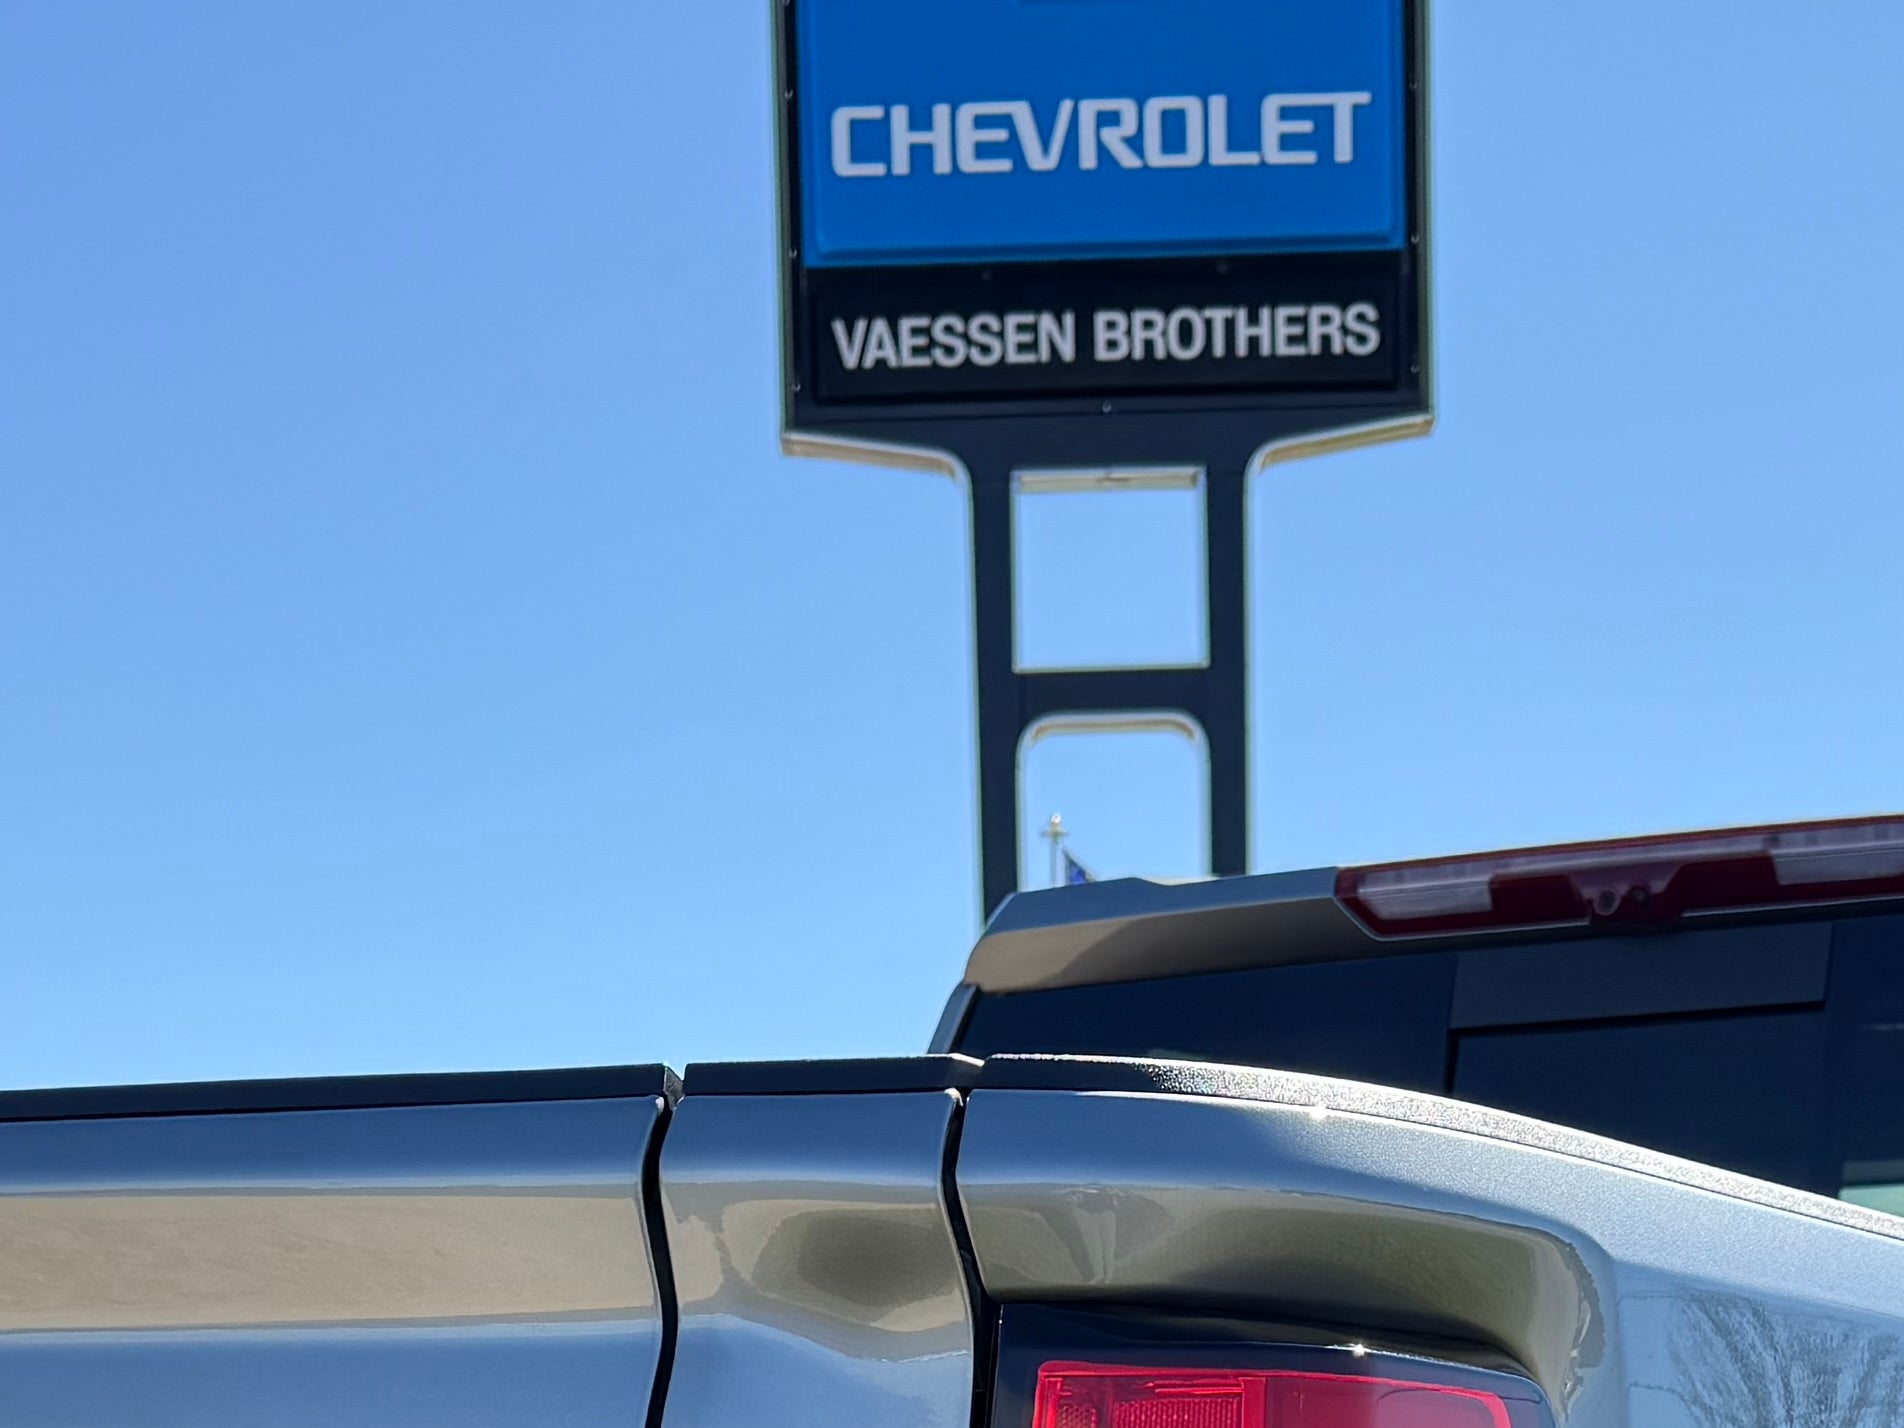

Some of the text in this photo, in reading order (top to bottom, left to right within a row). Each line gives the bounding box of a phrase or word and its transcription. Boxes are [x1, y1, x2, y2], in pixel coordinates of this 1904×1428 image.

[830, 91, 1372, 178] CHEVROLET
[831, 302, 1381, 370] VAESSEN BROTHERS
